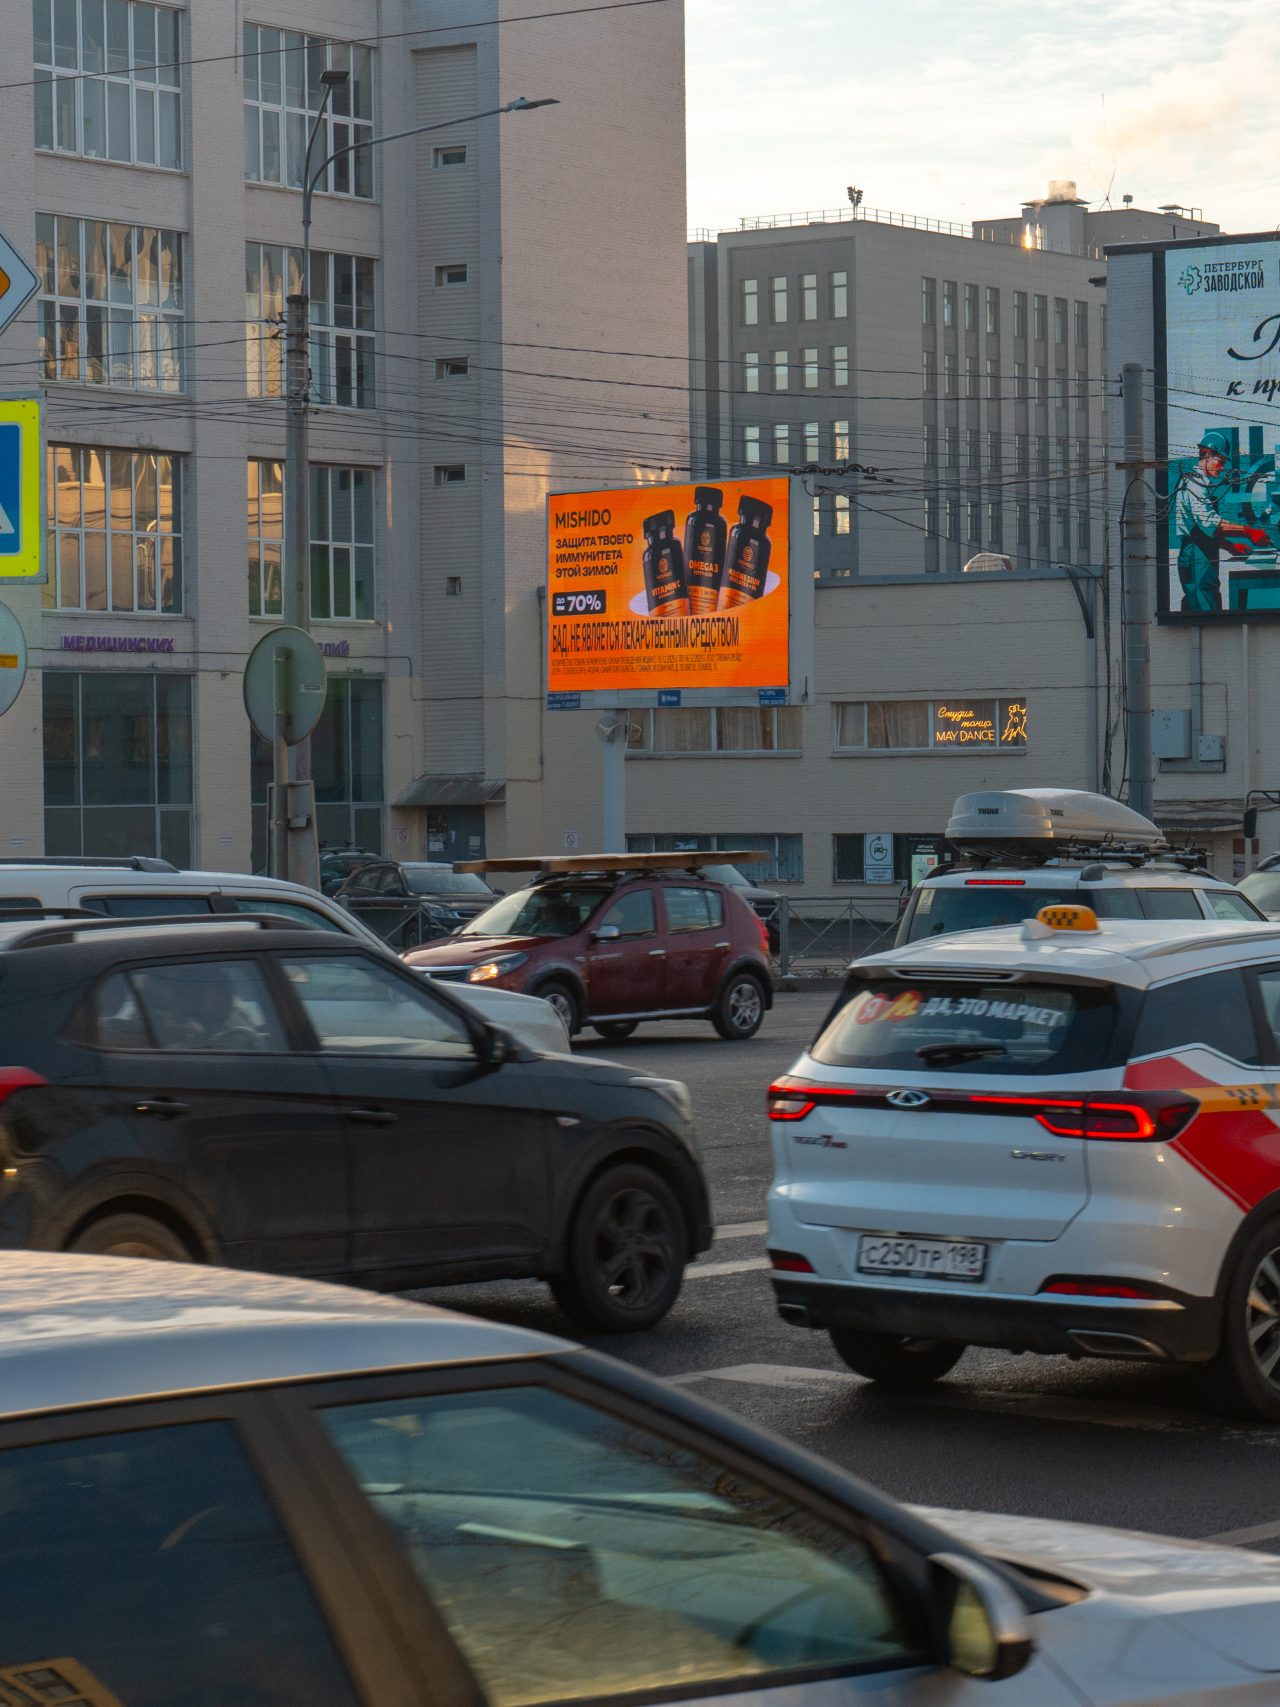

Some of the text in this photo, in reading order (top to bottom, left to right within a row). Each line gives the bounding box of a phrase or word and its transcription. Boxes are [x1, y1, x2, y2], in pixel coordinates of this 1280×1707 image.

[1204, 260, 1264, 273] ПЕТЕРБУРГ
[1204, 271, 1265, 292] ЗАВОДСКОЙ
[1226, 380, 1245, 397] к
[555, 509, 611, 529] MISHIDO
[555, 534, 633, 549] ЗАЩИТА ТВОЕГО
[555, 550, 623, 563] ИММУНИТЕТА
[555, 562, 618, 578] ЭТОЙ ЗИМОЙ
[688, 560, 719, 573] OMEGA 3
[651, 580, 676, 597] VITAMIN
[676, 580, 681, 588] C
[570, 623, 581, 652] НЕ
[582, 621, 619, 651] ЯВЛЯЕТСЯ
[620, 617, 688, 650] ЛЕКАРСТВЕННЫМ
[690, 616, 739, 652] СРЕДСТВОМ
[938, 706, 975, 721] Студия
[961, 720, 992, 728] танца
[936, 730, 995, 741] MAY DANCE
[956, 998, 986, 1016] ЭТО
[986, 1001, 1064, 1027] МАРКЕТ
[948, 1245, 979, 1265] 198
